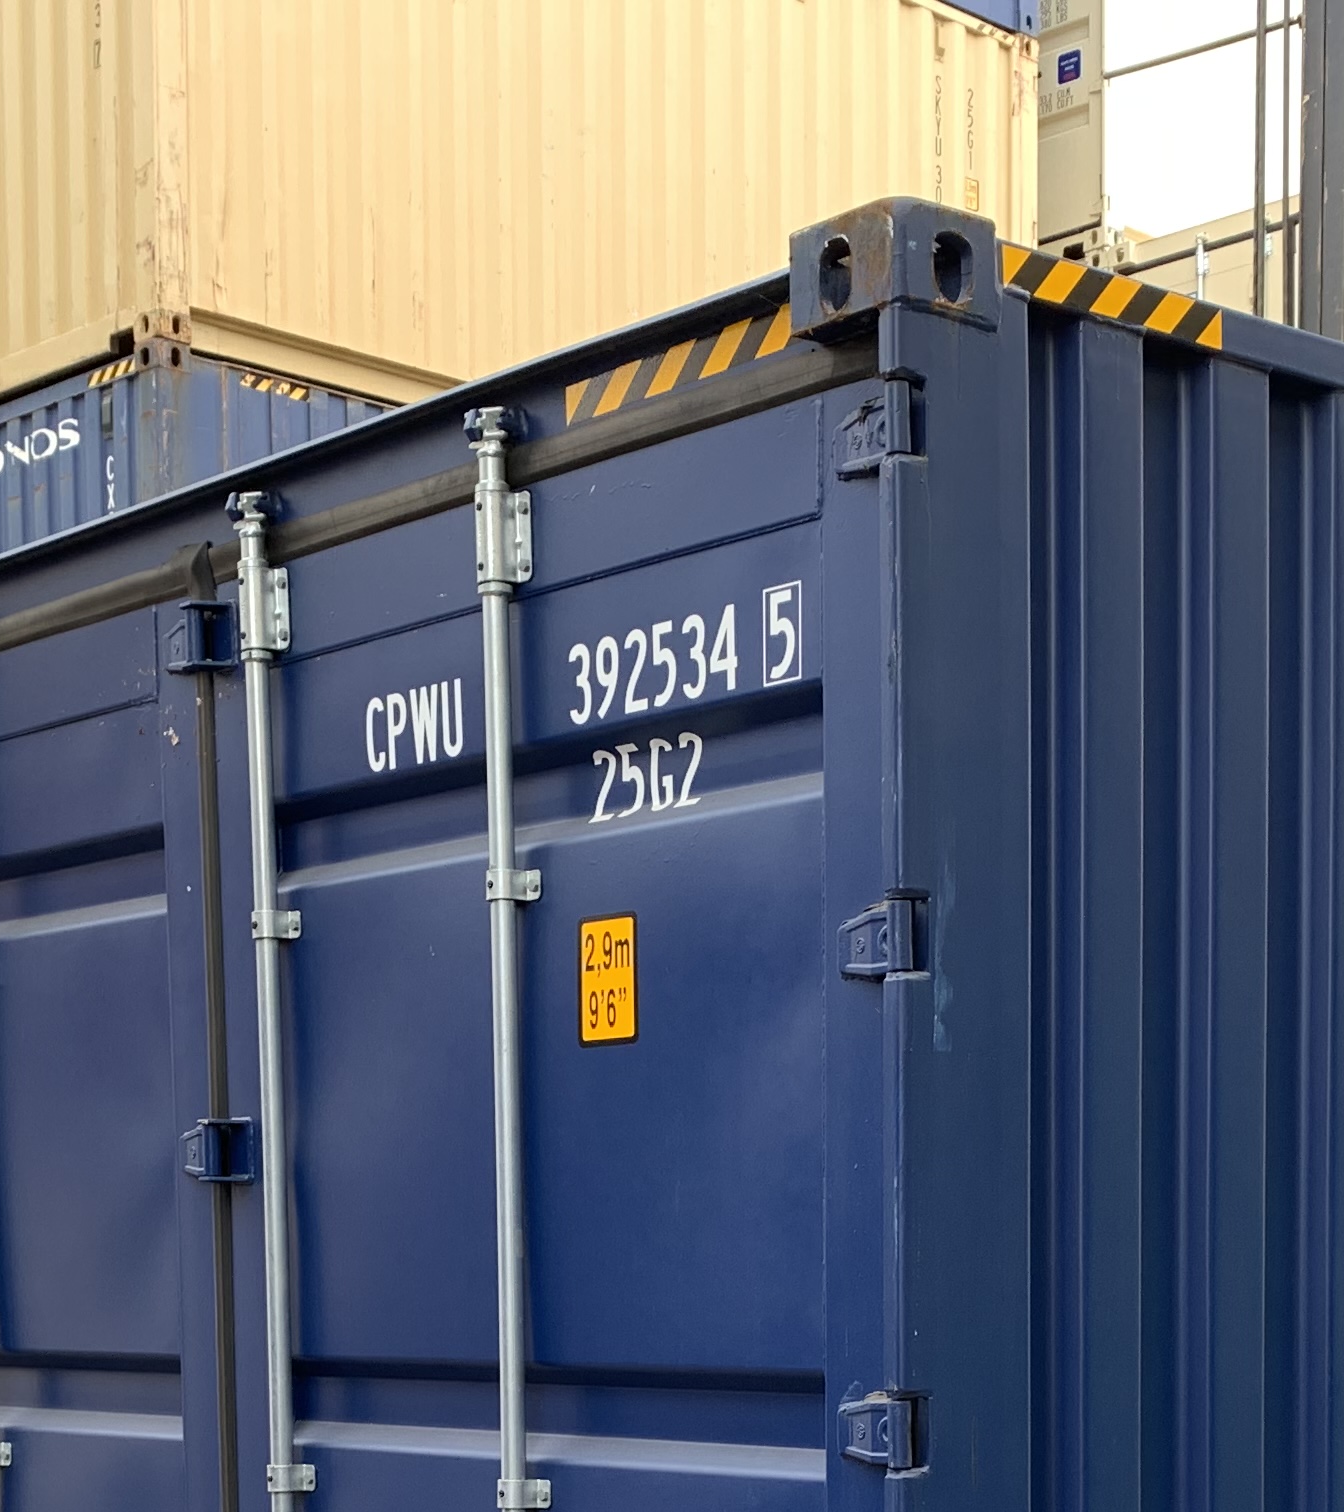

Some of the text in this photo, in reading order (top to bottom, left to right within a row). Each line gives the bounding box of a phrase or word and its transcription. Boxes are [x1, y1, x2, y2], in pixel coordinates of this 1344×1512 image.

[935, 75, 943, 157] SKYU
[106, 455, 116, 514] CX
[365, 677, 464, 773] CPWU
[568, 603, 739, 726] 392534
[587, 731, 704, 824] 25G2
[585, 931, 630, 978] 2,9m
